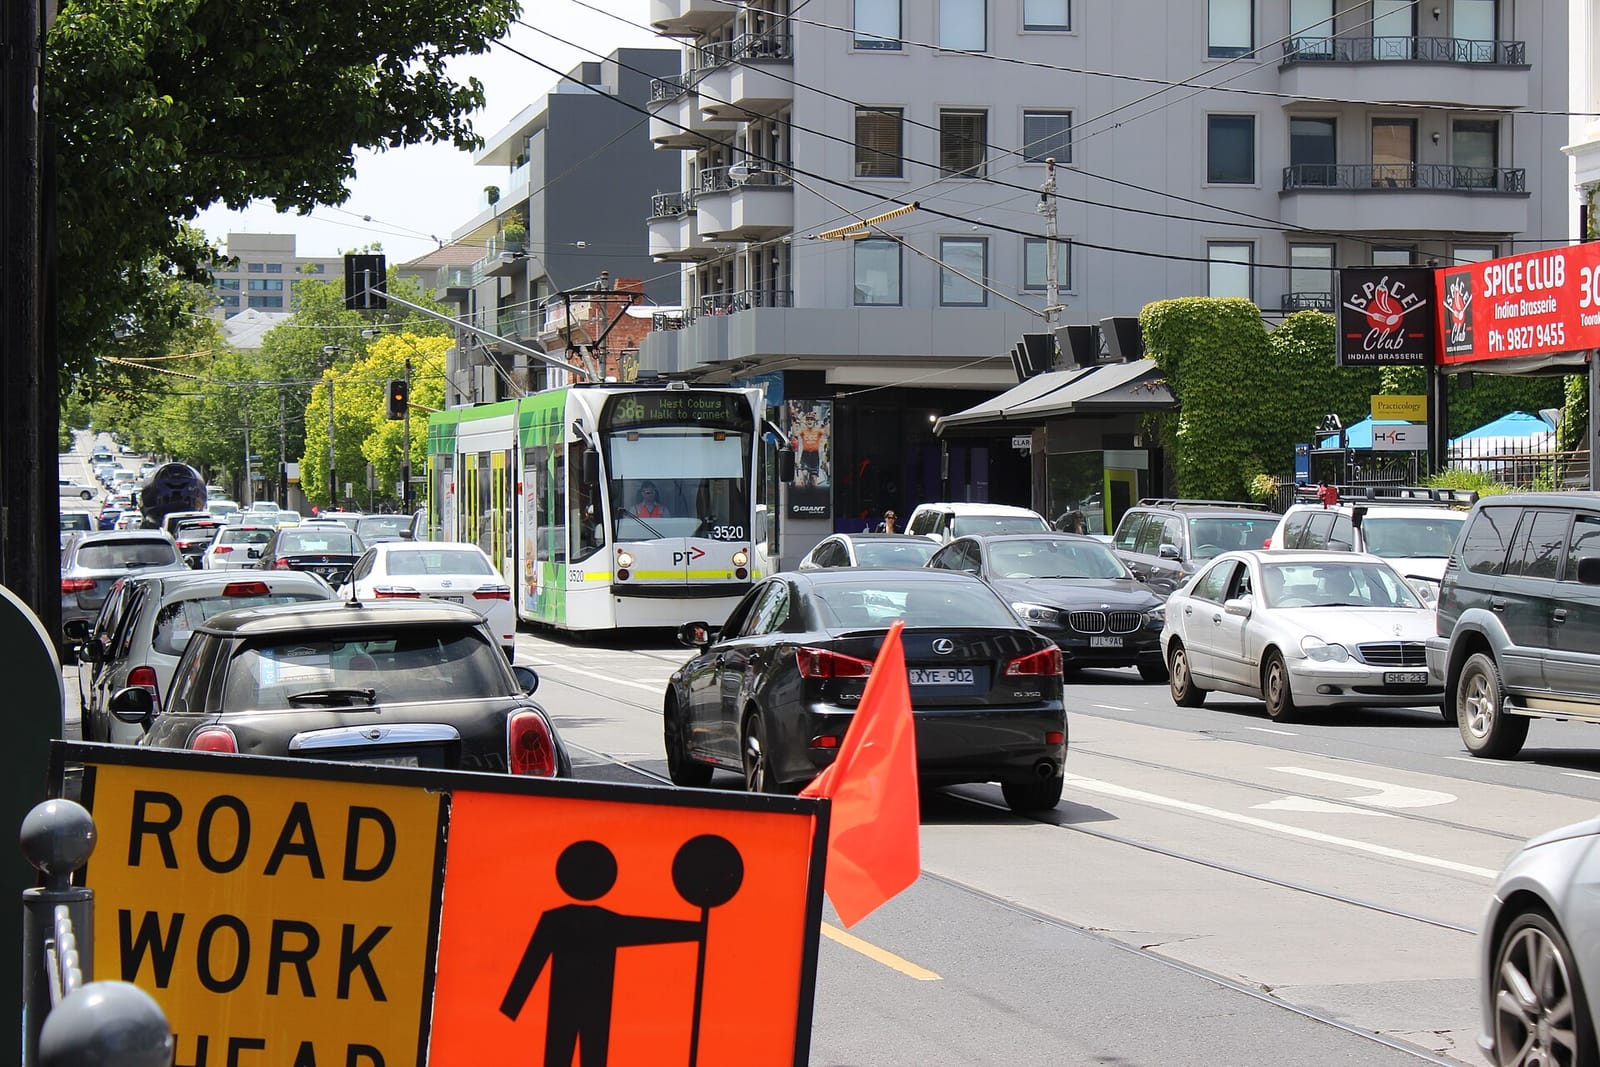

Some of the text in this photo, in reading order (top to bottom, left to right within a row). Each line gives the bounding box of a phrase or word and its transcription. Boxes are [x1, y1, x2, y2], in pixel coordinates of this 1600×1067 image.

[1483, 254, 1565, 298] SPICE CLUB
[1350, 275, 1418, 313] SPICE
[1494, 294, 1557, 320] Indian Brasserie
[1363, 327, 1405, 351] Club
[1488, 322, 1565, 353] Ph: 9827 9455
[650, 409, 729, 420] Walk to connect
[659, 399, 722, 409] West Coburg
[1377, 402, 1421, 412] Practicology
[1013, 439, 1031, 447] CLAR
[713, 526, 744, 539] 3520
[127, 789, 397, 882] ROAD
[118, 909, 393, 1003] WORK
